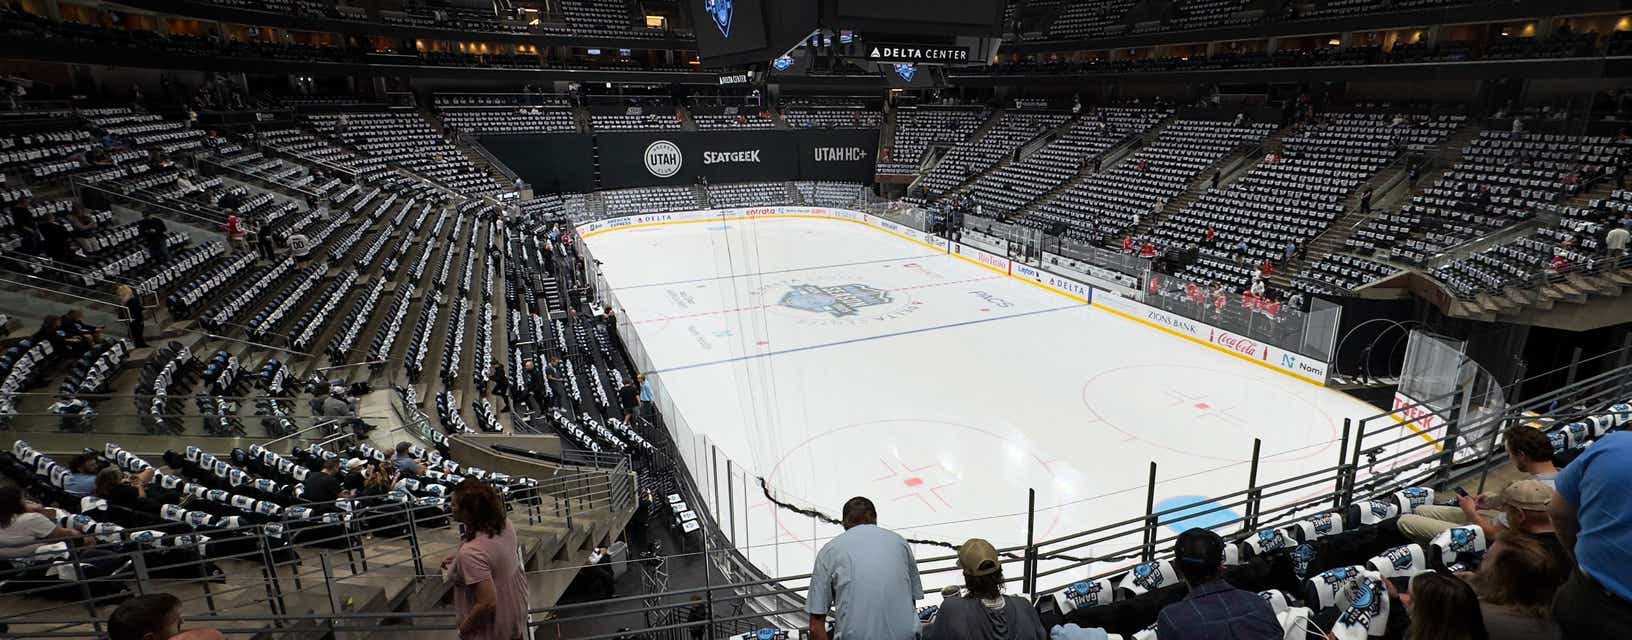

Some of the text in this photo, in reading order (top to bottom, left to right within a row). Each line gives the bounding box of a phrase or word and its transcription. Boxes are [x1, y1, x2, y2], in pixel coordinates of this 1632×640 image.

[883, 47, 967, 60] DELTA CENTER
[650, 153, 677, 166] UTAH
[703, 149, 761, 164] SEATGEEK
[814, 147, 868, 161] UTAH HC+
[746, 207, 776, 216] entrata
[1018, 264, 1035, 276] Layton
[1057, 279, 1085, 296] DELTA
[1147, 310, 1197, 334] ZIONS BANK
[1299, 361, 1324, 377] Nomi
